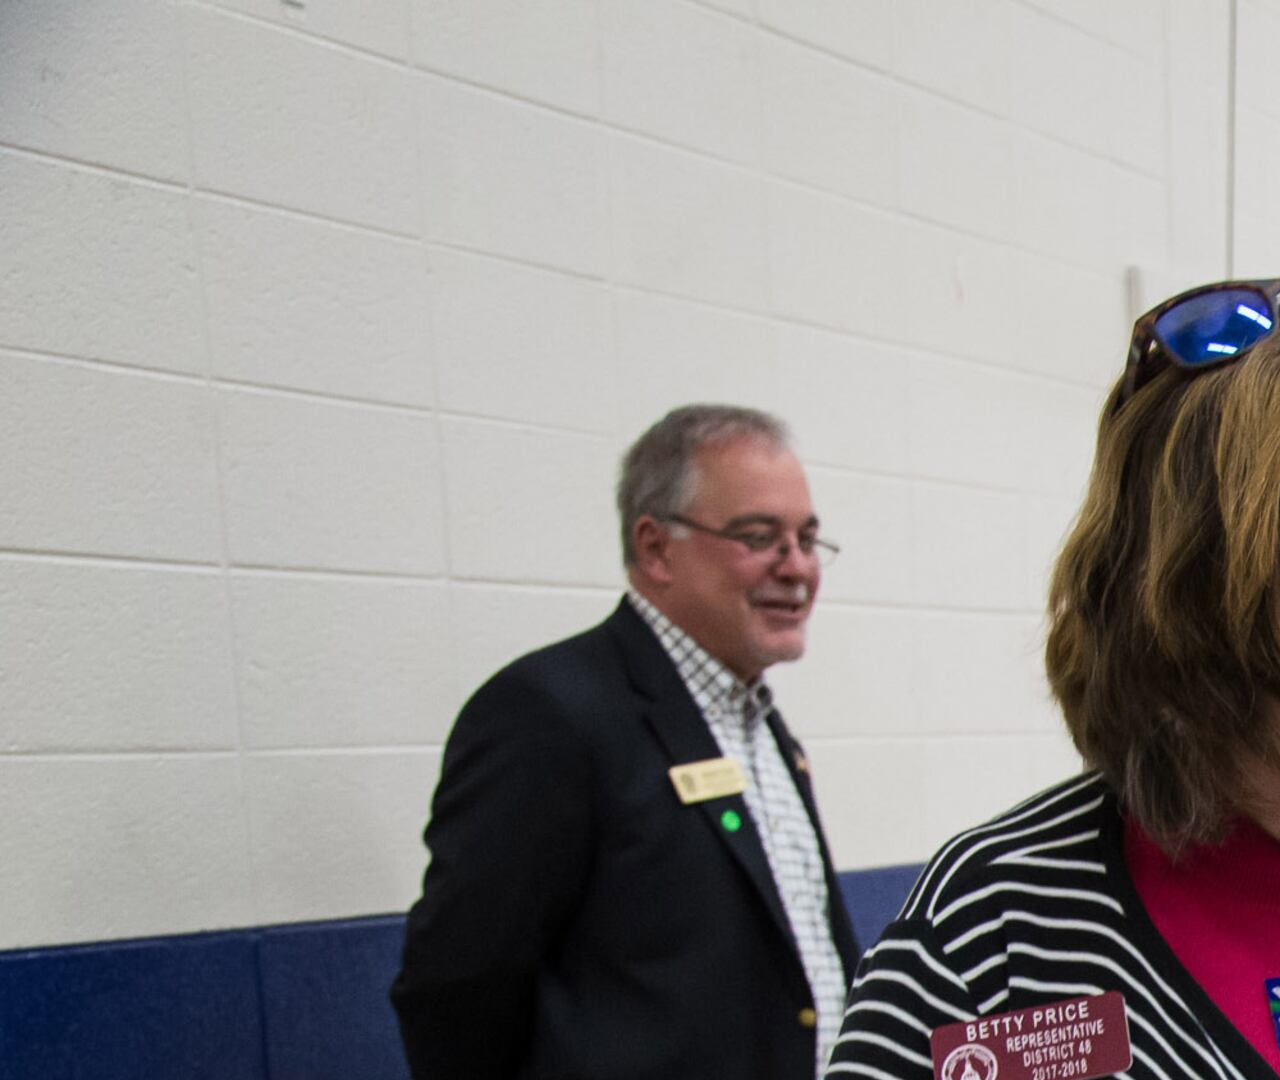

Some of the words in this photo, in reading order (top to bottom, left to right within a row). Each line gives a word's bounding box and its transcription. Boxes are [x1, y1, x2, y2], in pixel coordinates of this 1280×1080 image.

[966, 1014, 1025, 1042] BETTY
[1033, 1000, 1090, 1028] PRICE
[1006, 1019, 1104, 1053] REPRESENTATIVE
[1023, 1042, 1075, 1068] DISTRICT
[1078, 1039, 1092, 1055] 48
